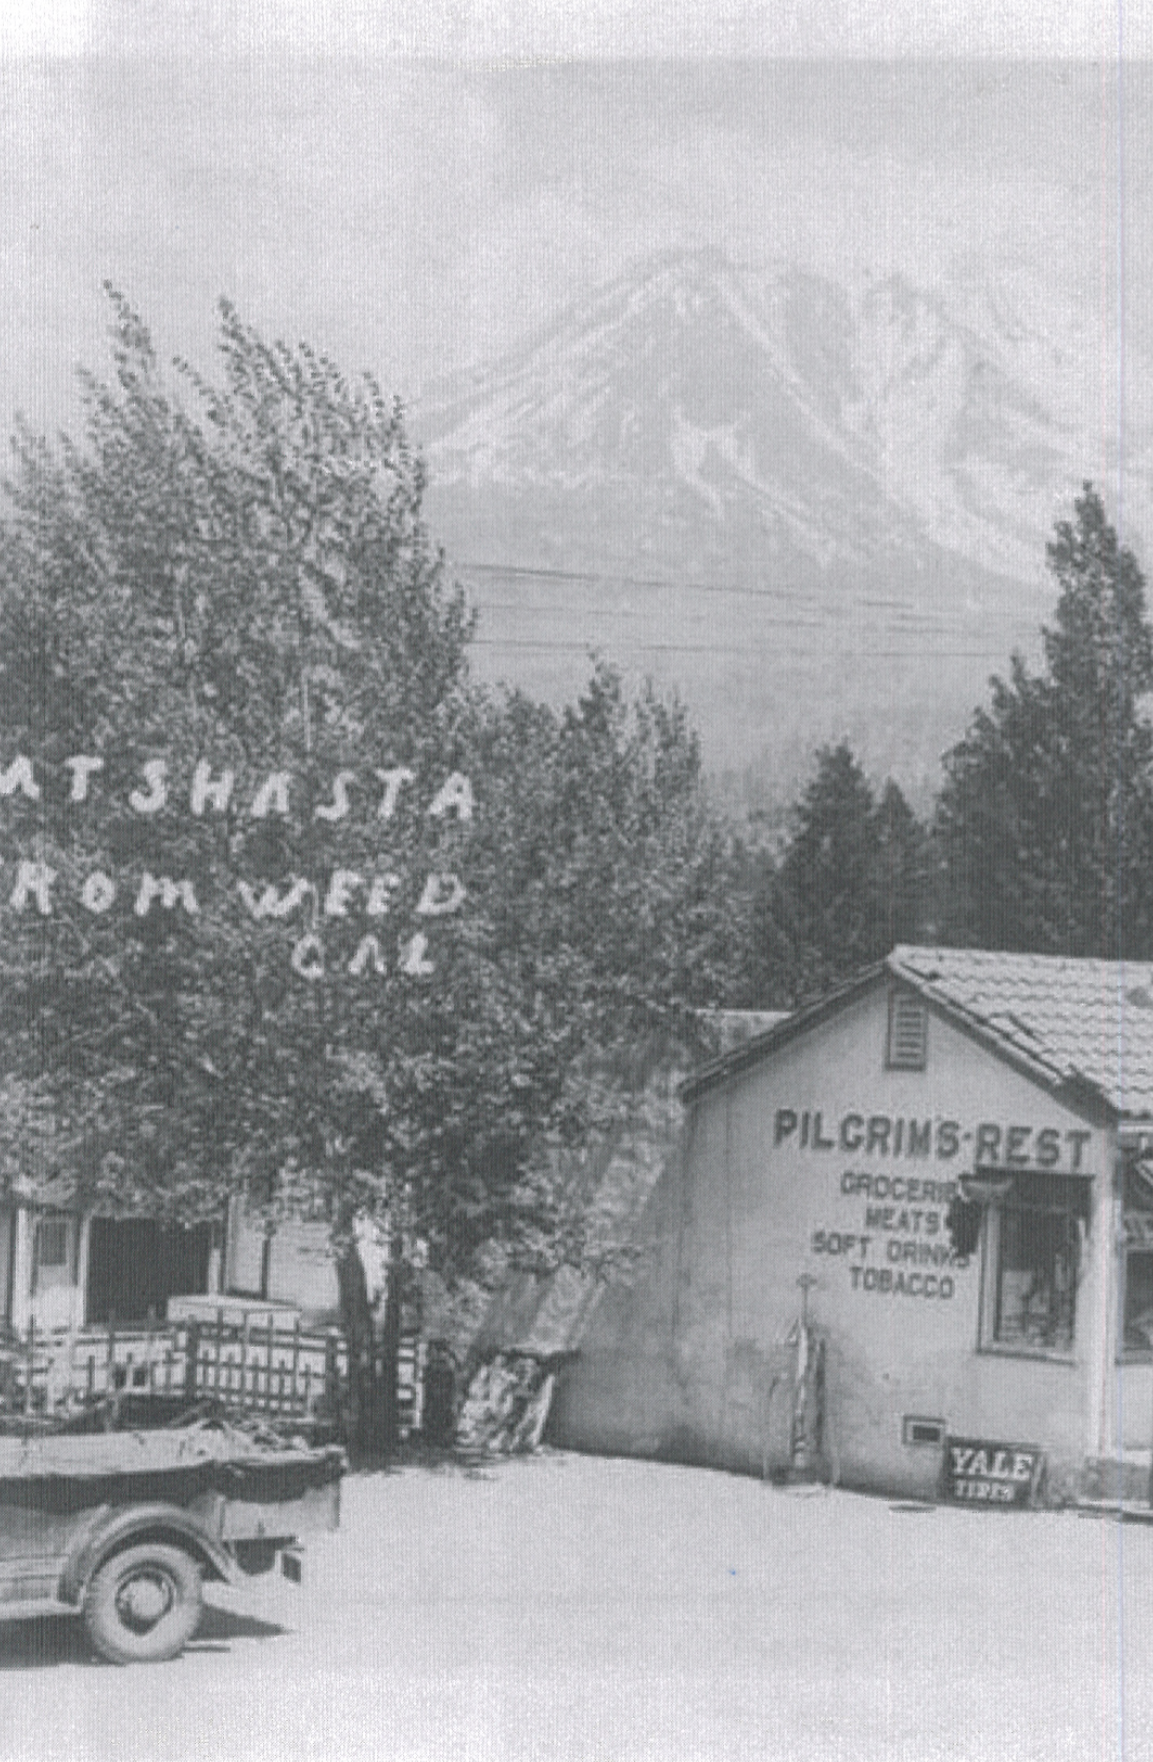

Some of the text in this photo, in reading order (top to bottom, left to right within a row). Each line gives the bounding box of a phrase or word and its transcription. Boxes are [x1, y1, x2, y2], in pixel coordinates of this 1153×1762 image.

[865, 1206, 940, 1236] MEATS
[811, 1229, 871, 1259] SOFT
[850, 1266, 955, 1300] TOBACCO
[952, 1447, 1034, 1482] YALE
